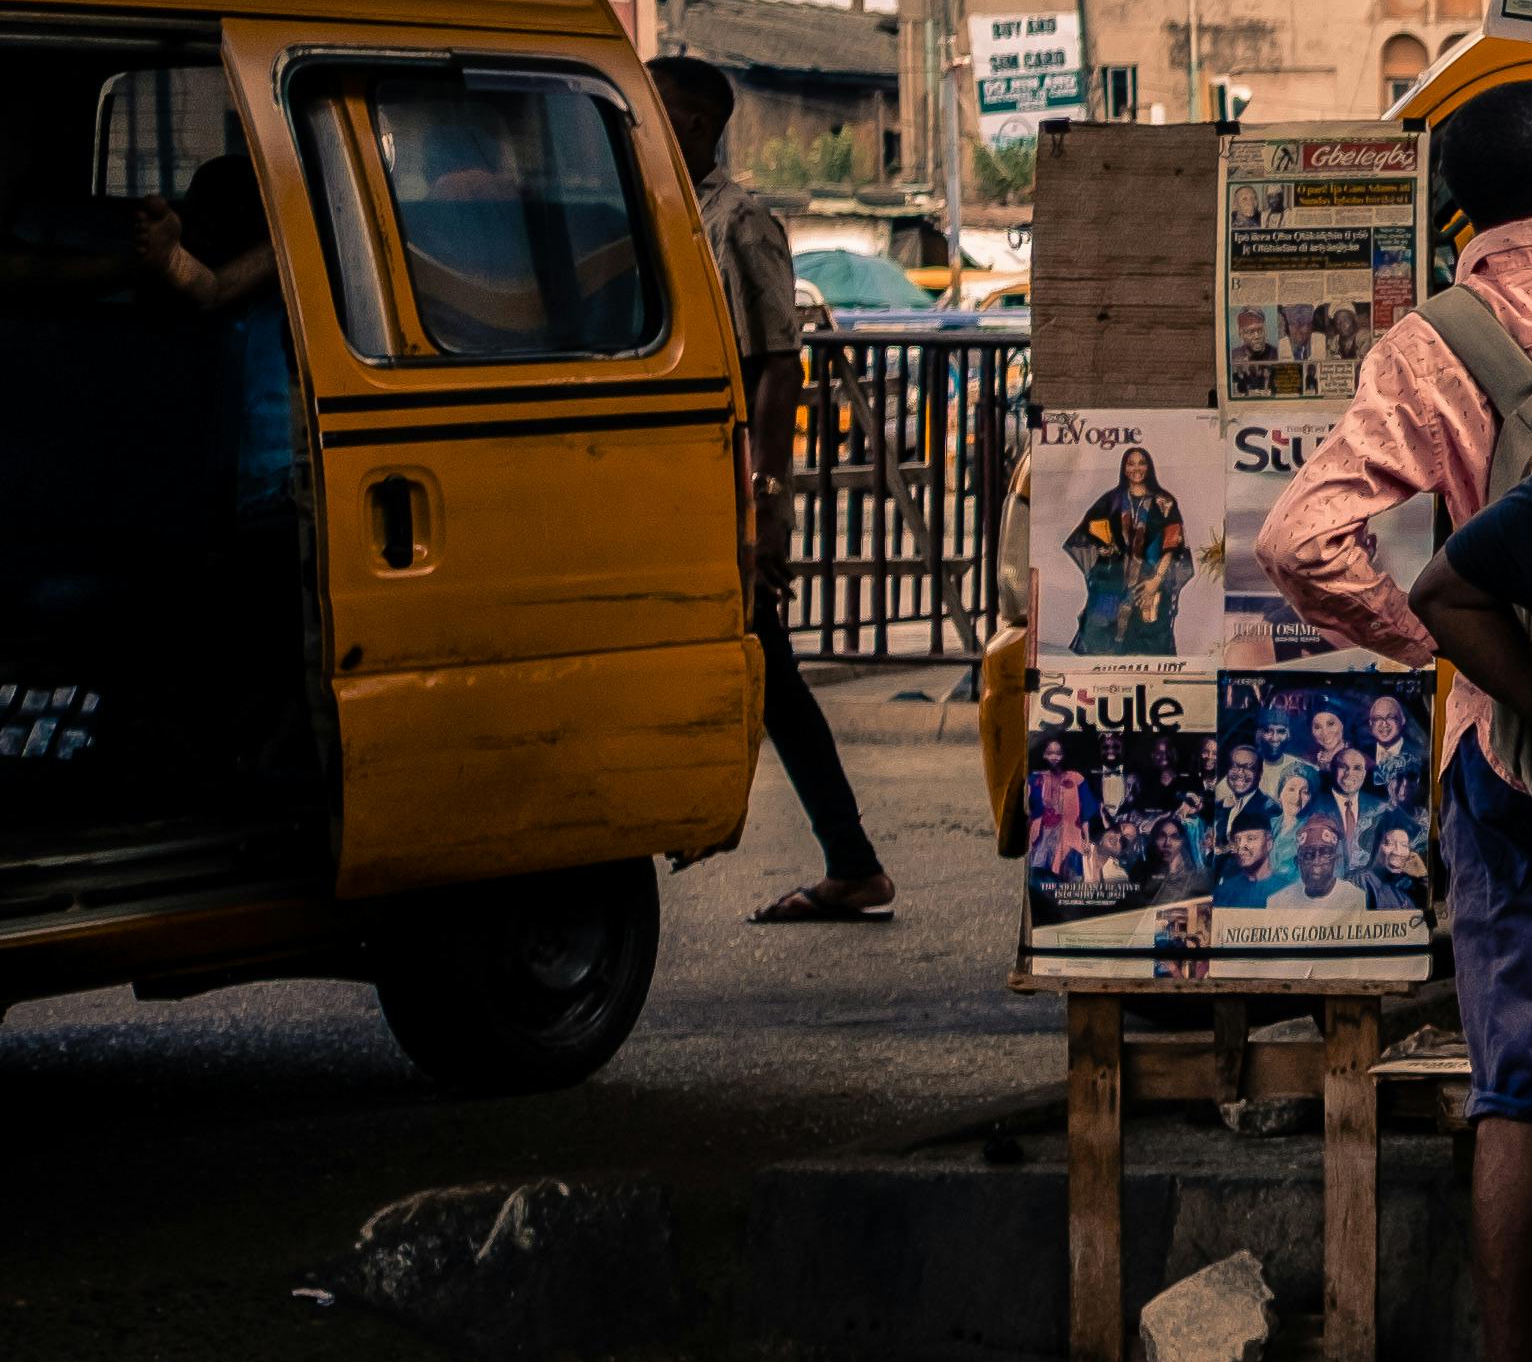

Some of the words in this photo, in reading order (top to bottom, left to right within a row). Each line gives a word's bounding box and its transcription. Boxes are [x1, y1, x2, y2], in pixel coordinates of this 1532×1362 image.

[1041, 685, 1184, 733] Style
[1226, 926, 1289, 944] NIGERIA'S
[1291, 924, 1346, 942] GLOBAL
[1346, 921, 1407, 940] LEADERS
